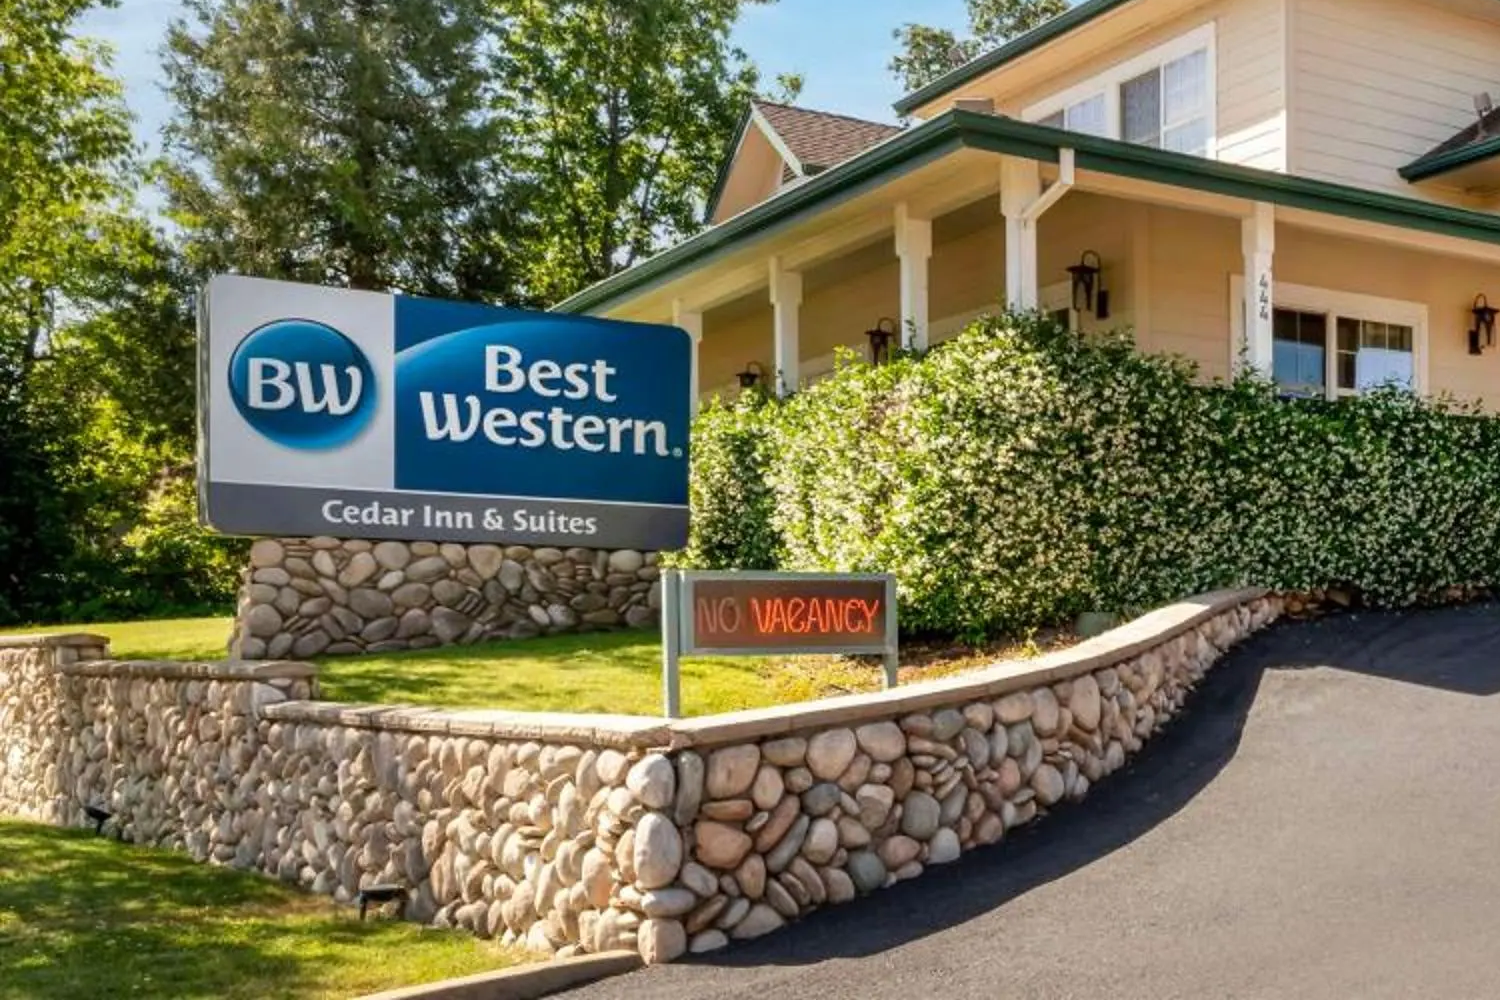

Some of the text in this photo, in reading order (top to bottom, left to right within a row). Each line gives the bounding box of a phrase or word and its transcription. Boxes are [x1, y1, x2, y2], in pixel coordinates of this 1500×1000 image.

[247, 356, 363, 416] BW
[484, 344, 617, 403] Best
[322, 499, 598, 536] Cedar Inn & Suites
[699, 597, 879, 634] NO VACANCY
